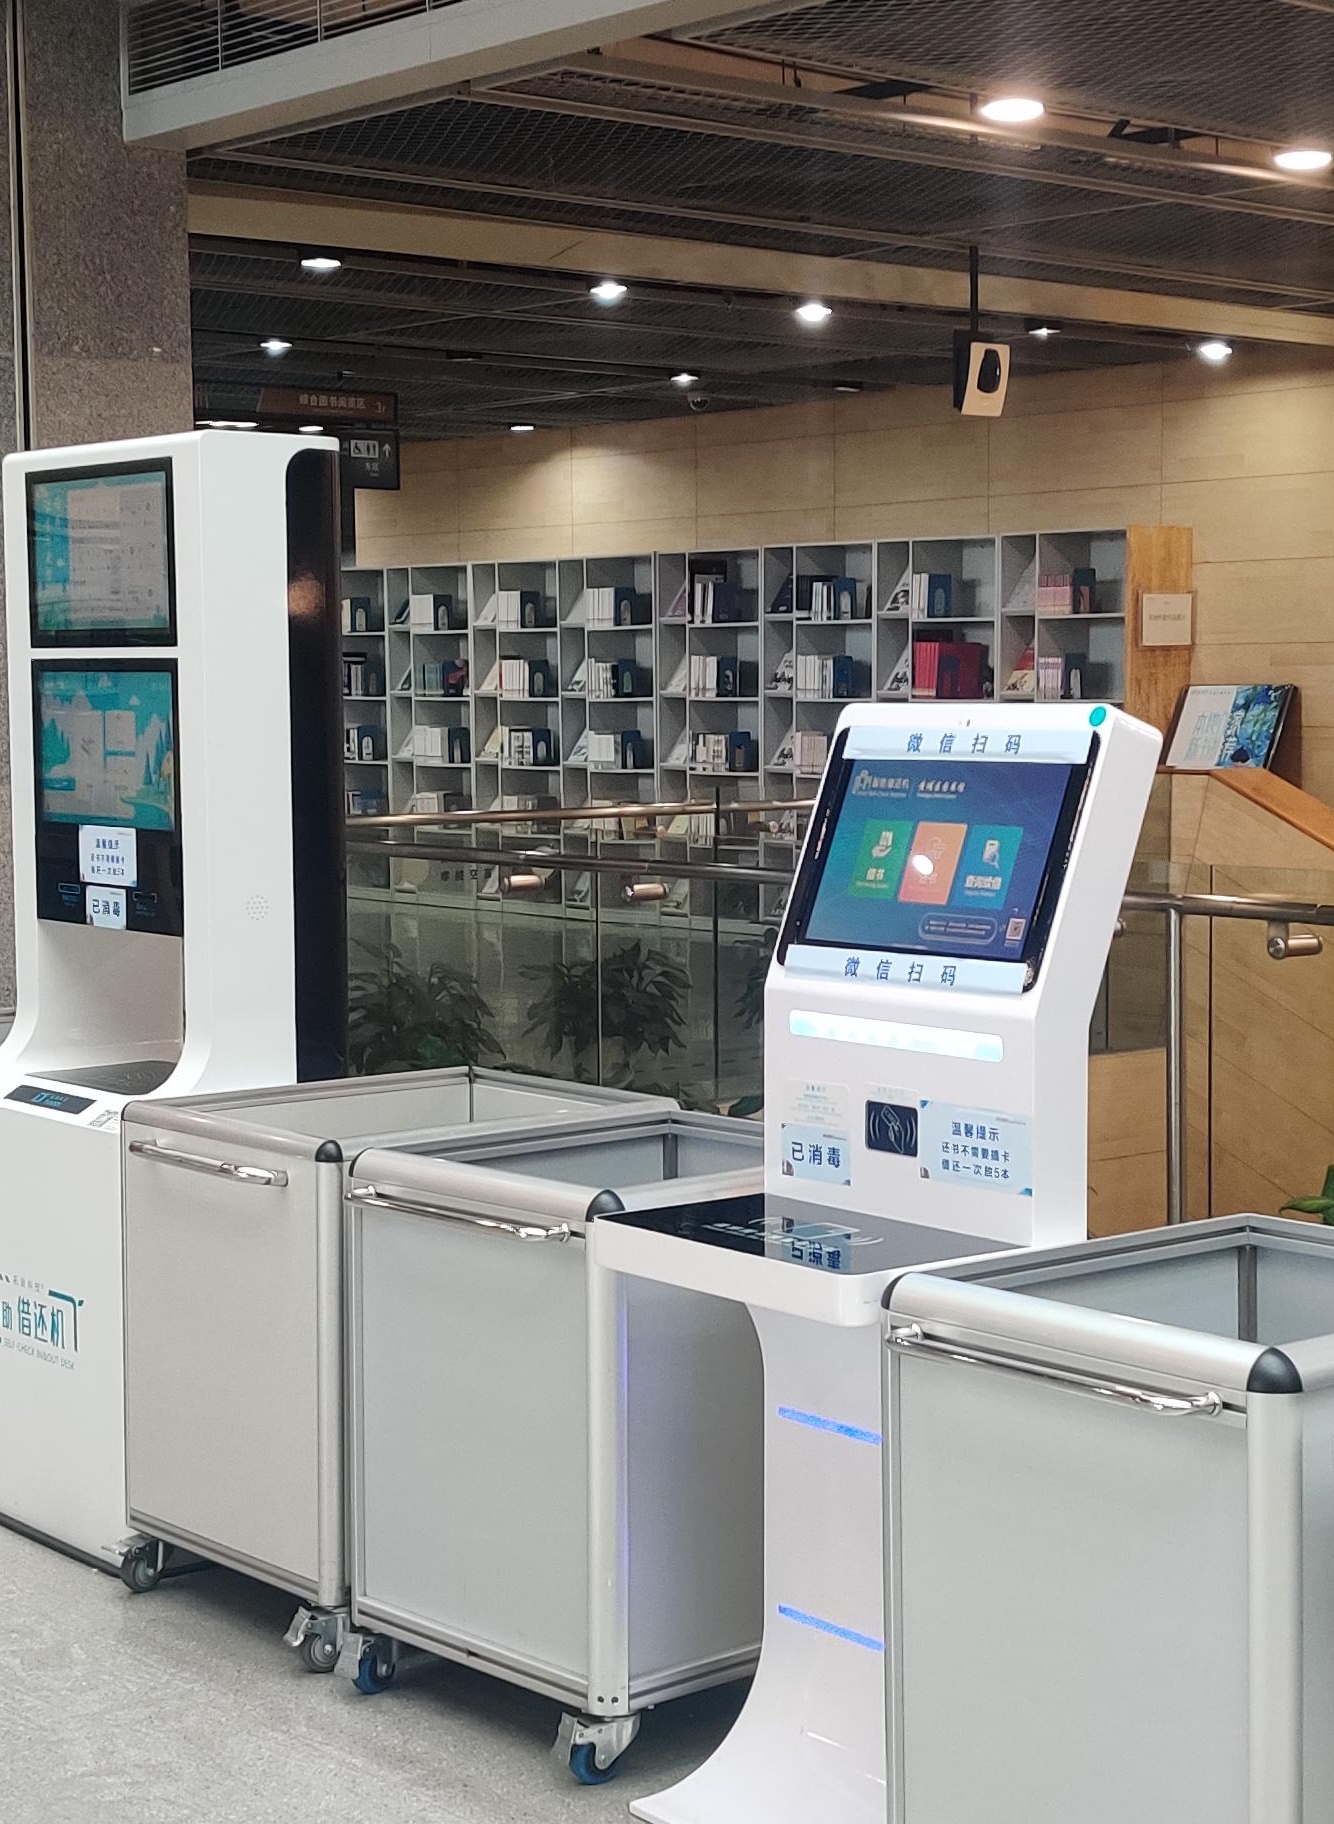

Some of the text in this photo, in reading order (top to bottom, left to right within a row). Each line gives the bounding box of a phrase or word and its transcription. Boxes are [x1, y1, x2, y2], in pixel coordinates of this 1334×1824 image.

[907, 733, 1022, 754] 微信扫码
[844, 956, 957, 986] 微信扫码
[952, 1121, 1000, 1142] 温馨提示
[791, 1141, 841, 1169] 已消毒
